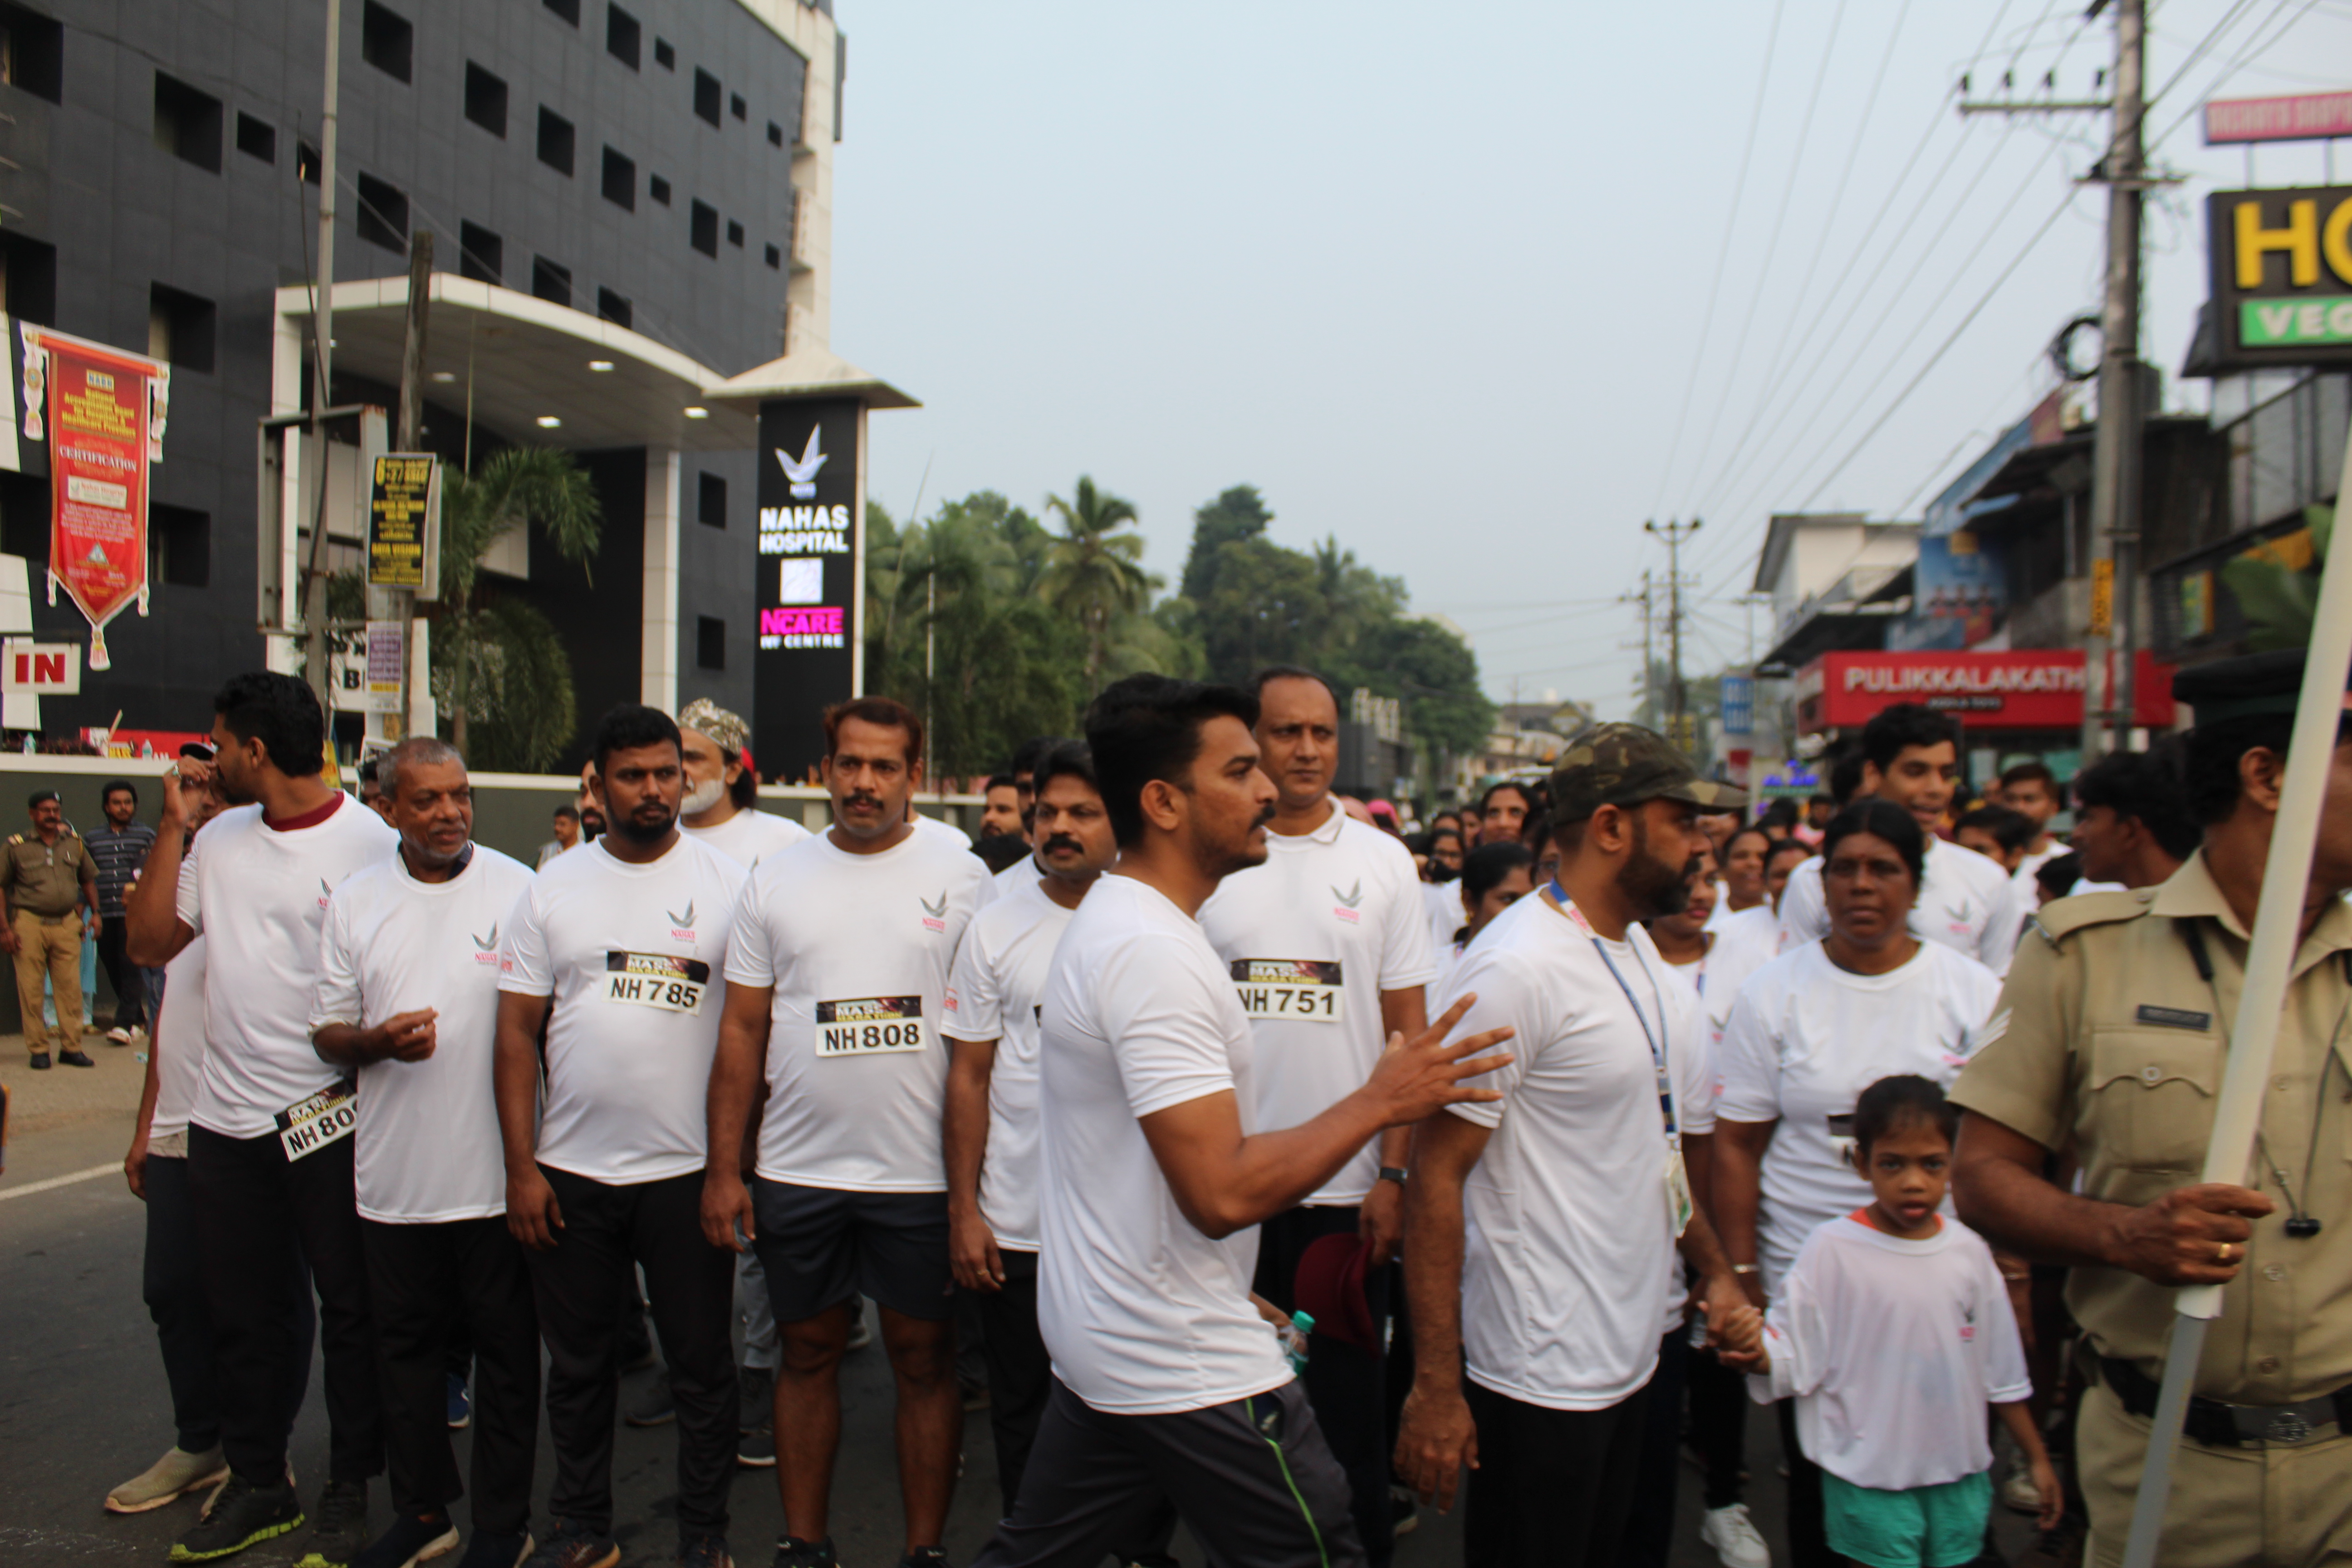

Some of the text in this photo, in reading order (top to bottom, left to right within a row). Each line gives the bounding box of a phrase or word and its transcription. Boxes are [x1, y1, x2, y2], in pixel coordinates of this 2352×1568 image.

[60, 446, 137, 473] CERTIFICATION
[760, 504, 850, 531] NAHAS
[759, 531, 850, 554] HOSPITAL
[760, 607, 845, 635] NCARE
[784, 633, 845, 649] CENTRE
[16, 653, 66, 683] IN
[611, 977, 699, 1008] NH 785
[1237, 989, 1334, 1015] NH 751
[825, 1024, 920, 1051] NH 808
[288, 1098, 357, 1153] NH 80
